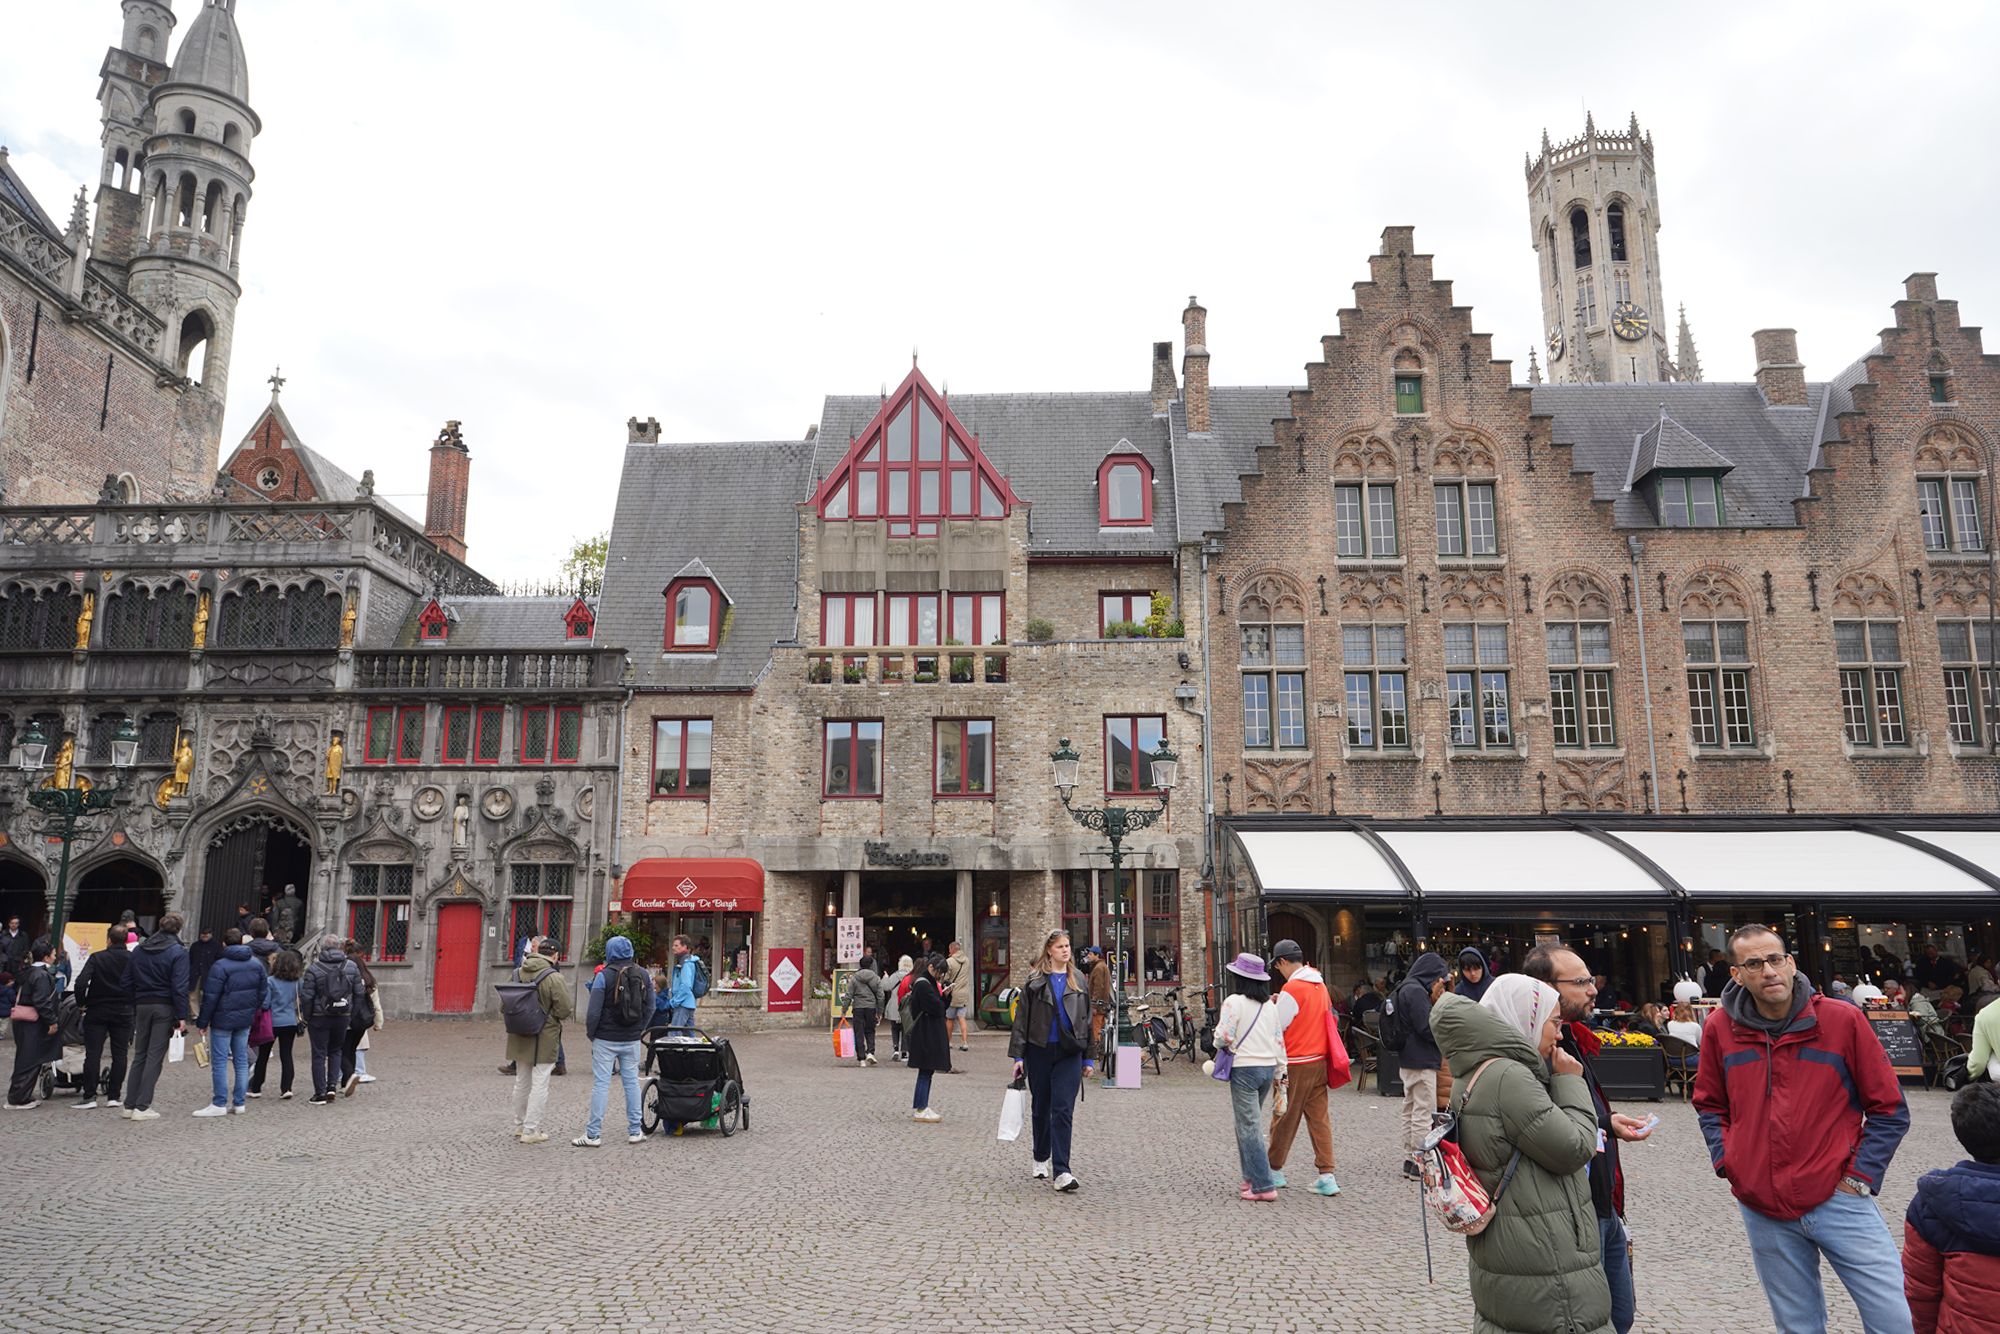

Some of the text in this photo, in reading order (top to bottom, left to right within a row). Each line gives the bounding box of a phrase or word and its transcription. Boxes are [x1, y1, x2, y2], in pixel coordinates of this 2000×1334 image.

[864, 840, 889, 854] ter
[868, 849, 949, 869] steeghere
[632, 898, 737, 910] Chocolate Factory De Burgh
